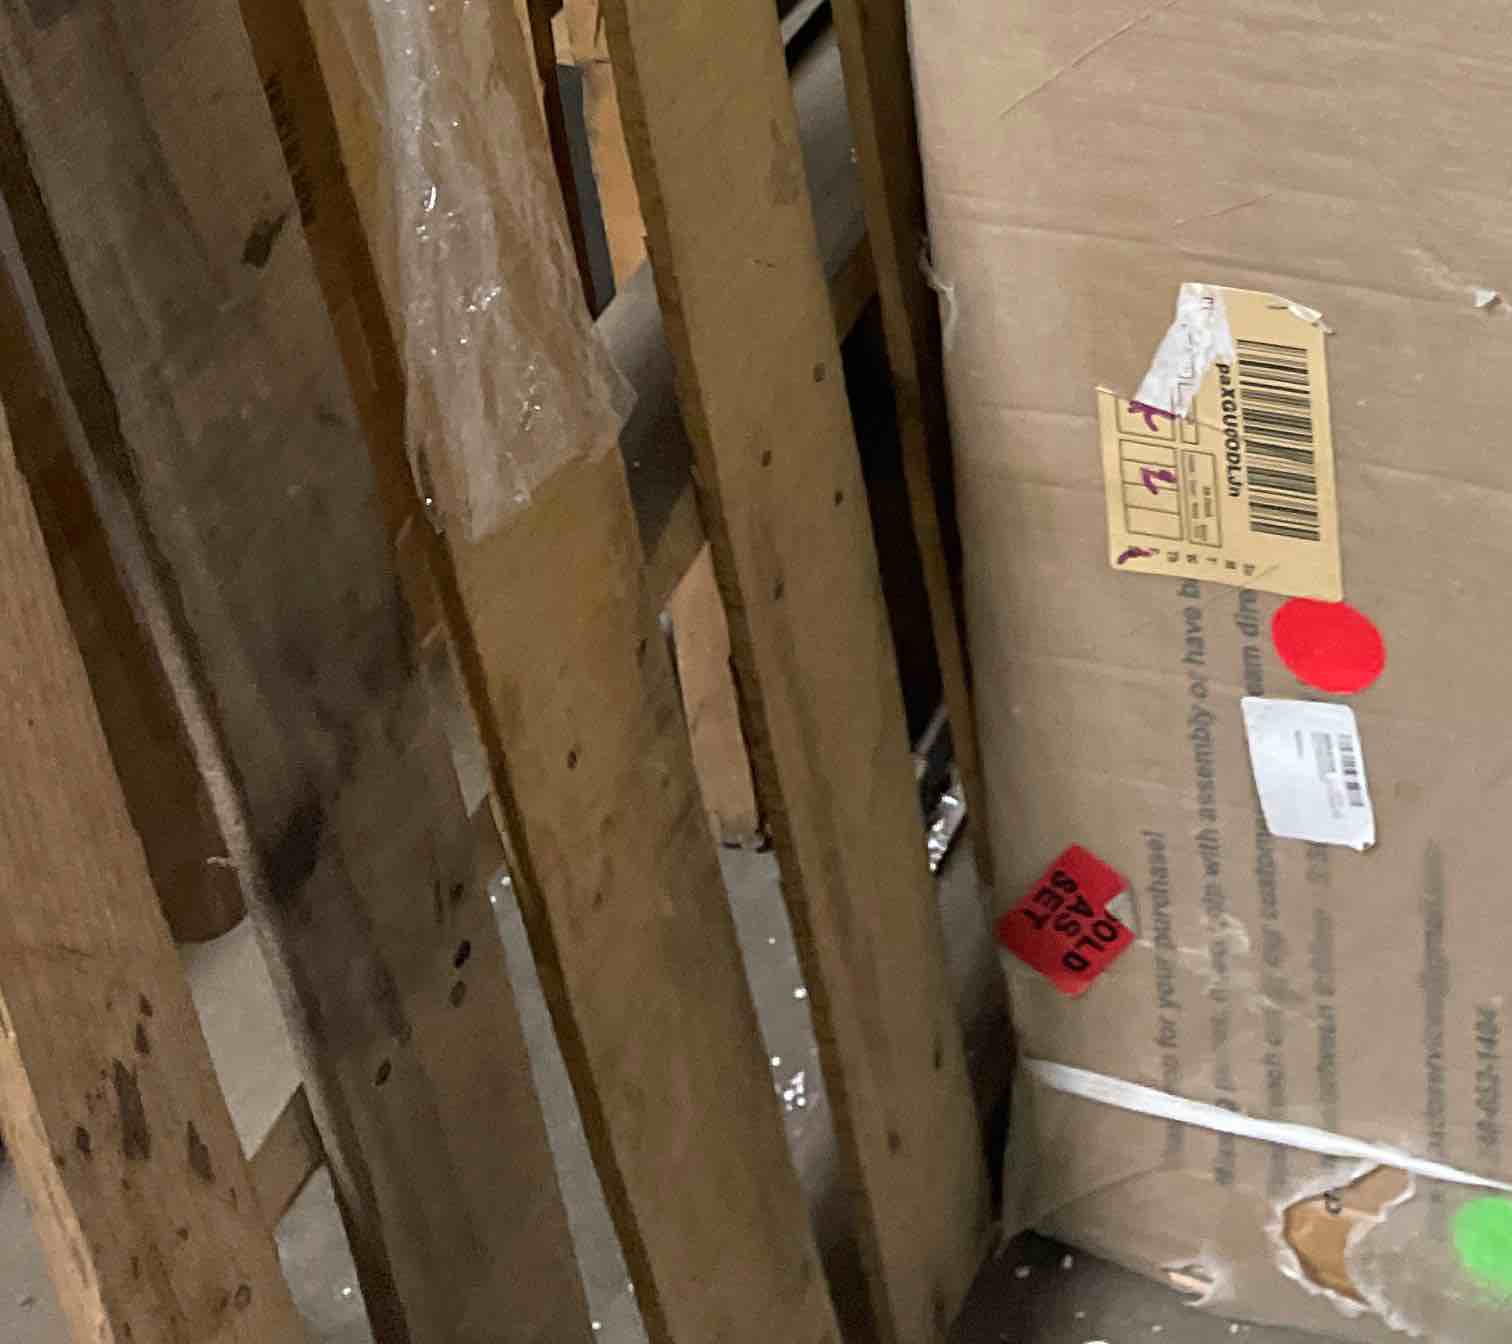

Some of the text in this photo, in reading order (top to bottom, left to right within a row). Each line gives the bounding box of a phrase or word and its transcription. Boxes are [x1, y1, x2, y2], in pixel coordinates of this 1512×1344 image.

[1181, 607, 1207, 666] have
[1186, 670, 1208, 700] or
[1186, 704, 1217, 823] assembly
[1194, 828, 1219, 877] with
[1060, 910, 1119, 973] OLD
[1152, 957, 1179, 1010] your
[1156, 1015, 1179, 1049] for
